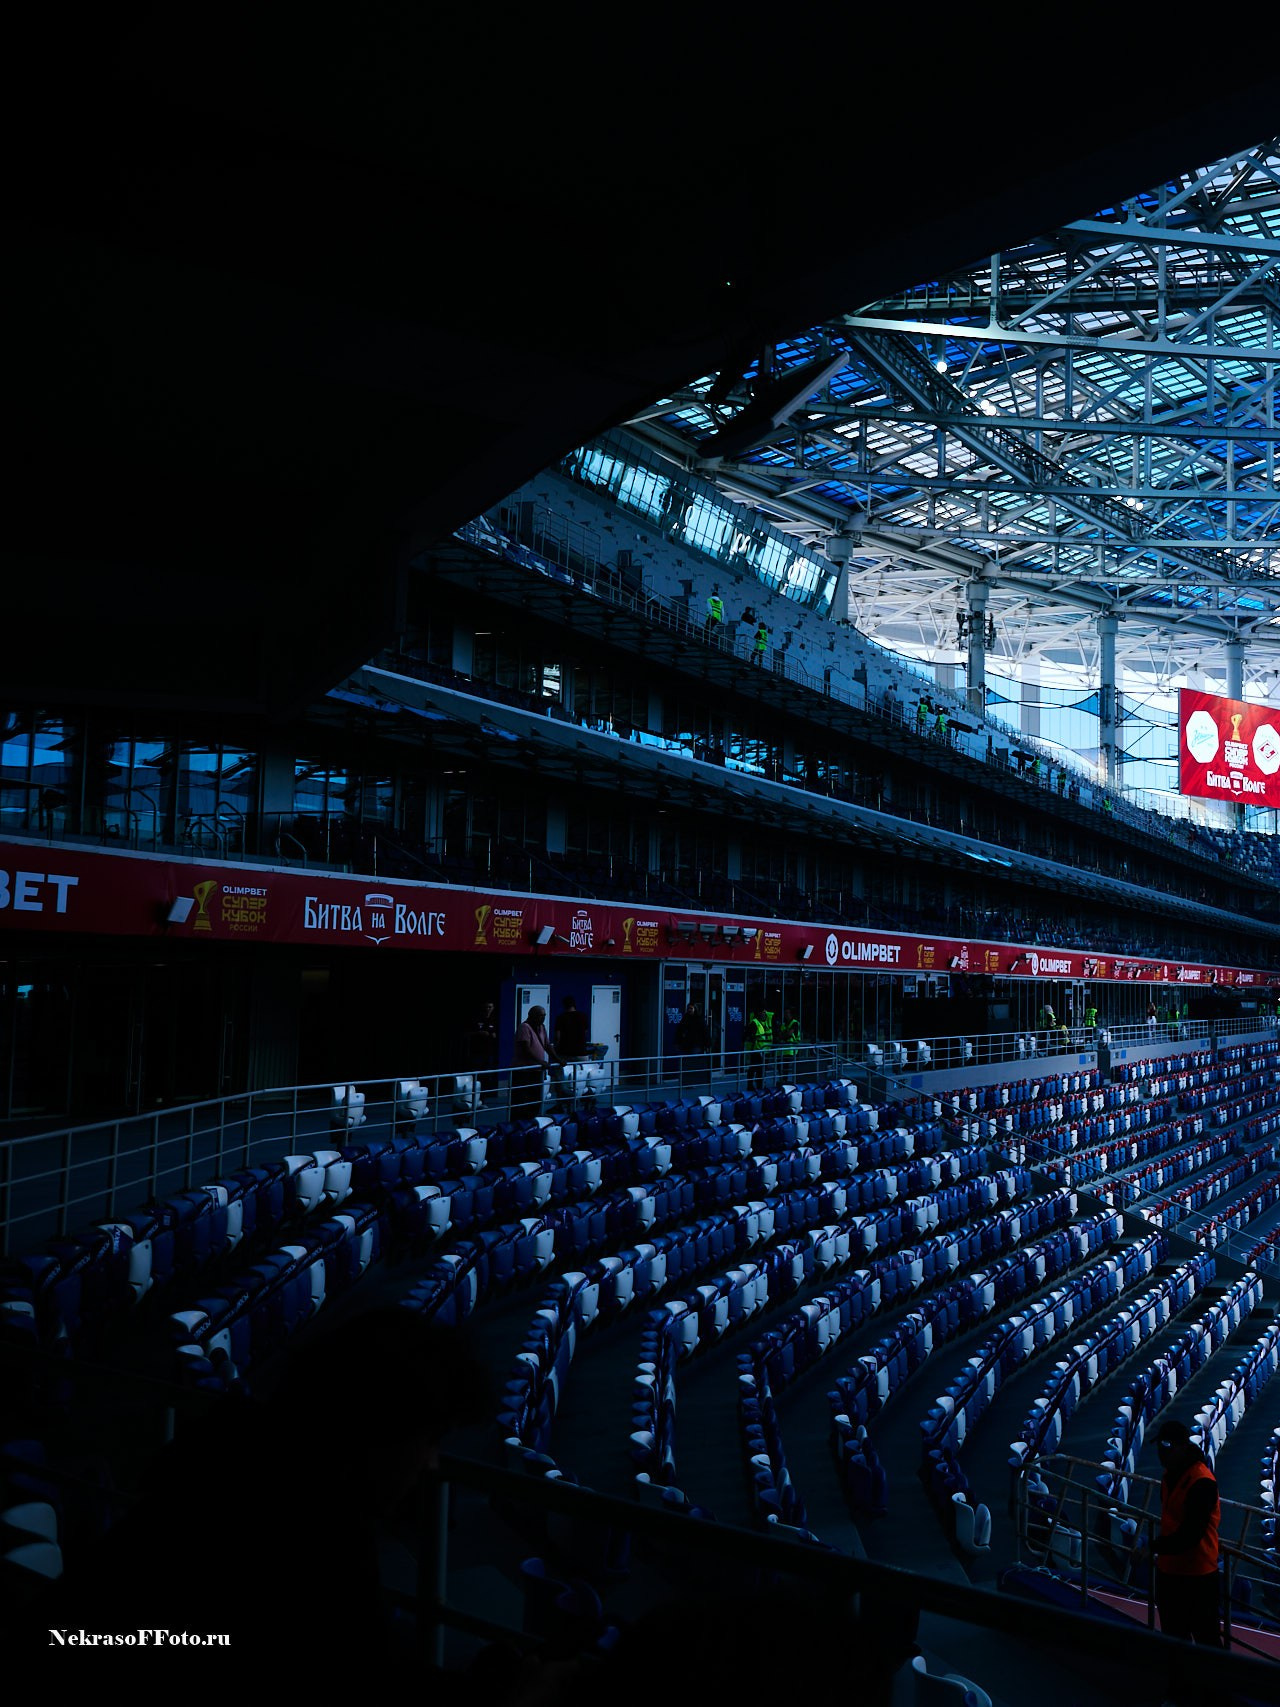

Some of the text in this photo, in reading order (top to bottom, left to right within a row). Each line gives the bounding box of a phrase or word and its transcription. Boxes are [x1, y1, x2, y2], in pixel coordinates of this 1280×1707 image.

[222, 885, 268, 897] OLIMPBET
[493, 908, 523, 917] OLIMPBET
[841, 940, 901, 964] OLIMPBET
[1039, 957, 1072, 974] OLIMPBET
